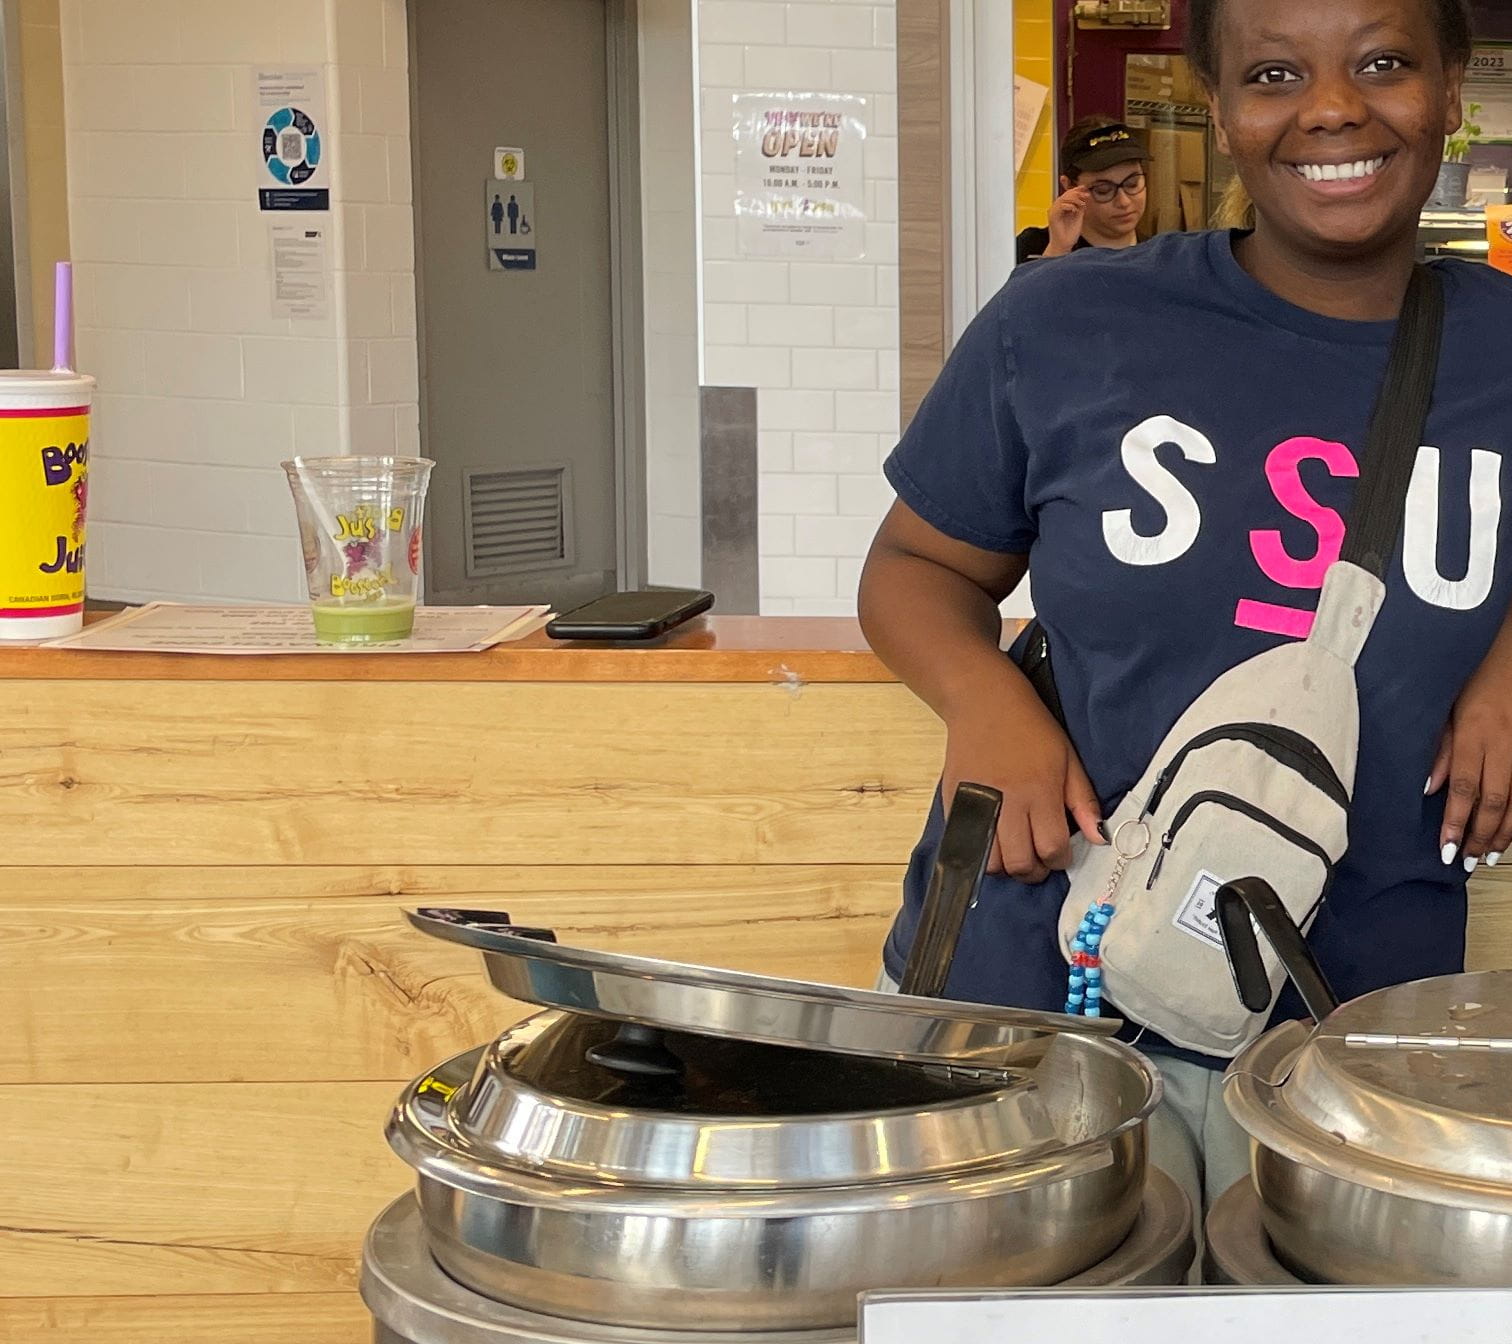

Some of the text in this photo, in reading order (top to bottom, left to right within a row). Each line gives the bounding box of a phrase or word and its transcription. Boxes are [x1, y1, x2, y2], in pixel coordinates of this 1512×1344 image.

[1472, 56, 1505, 68] 2023
[761, 130, 840, 158] OPEN
[1102, 415, 1502, 611] SSU
